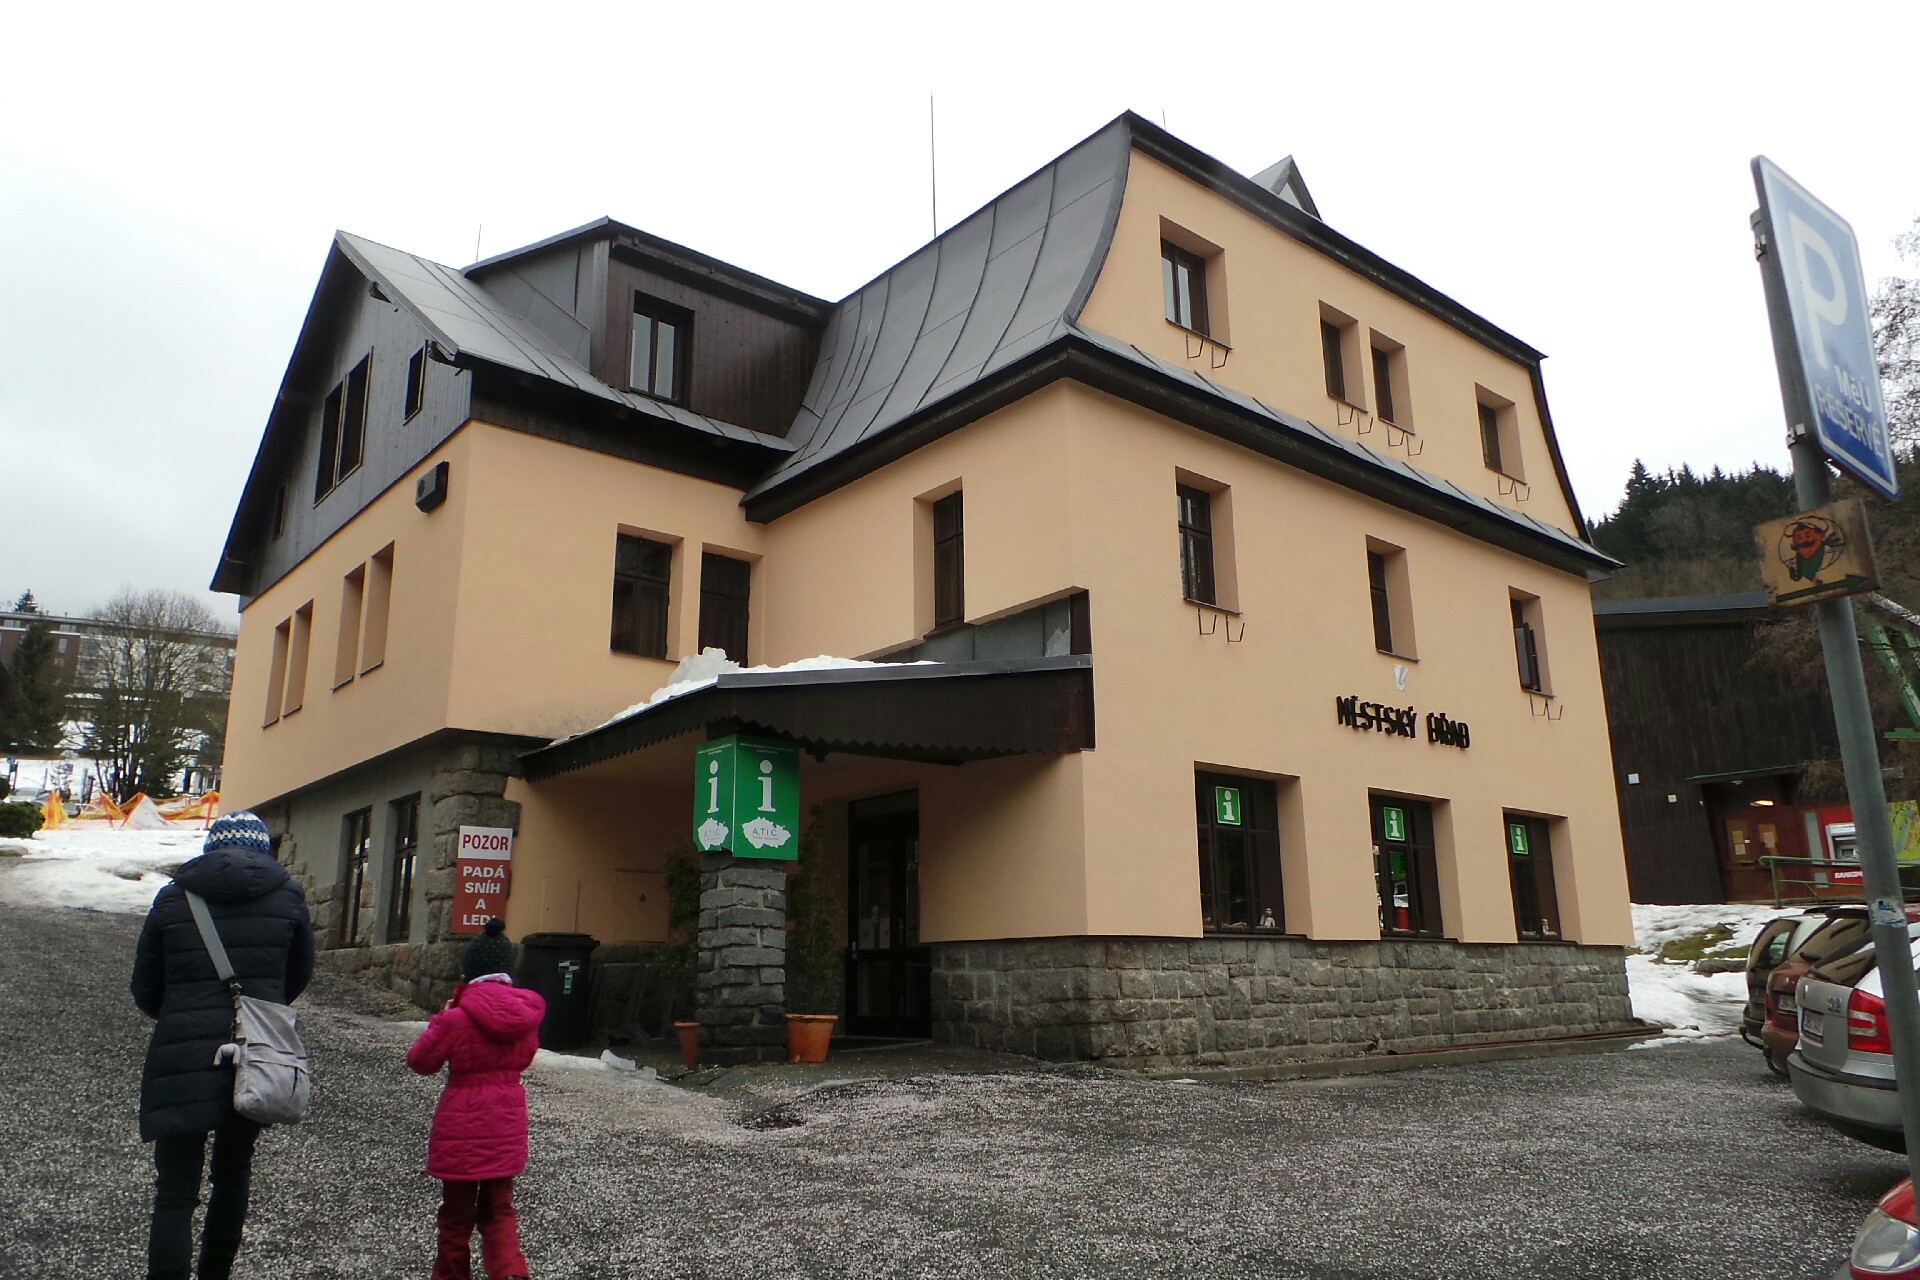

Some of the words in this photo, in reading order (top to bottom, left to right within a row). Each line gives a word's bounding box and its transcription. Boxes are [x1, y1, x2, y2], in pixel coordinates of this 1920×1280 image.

[1788, 209, 1848, 371] P
[1336, 694, 1417, 739] MĚSTSKÝ
[463, 834, 508, 850] POZOR
[462, 865, 505, 879] PADÁ
[464, 880, 501, 894] SNÍH
[475, 899, 486, 909] A
[463, 915, 495, 925] LED
